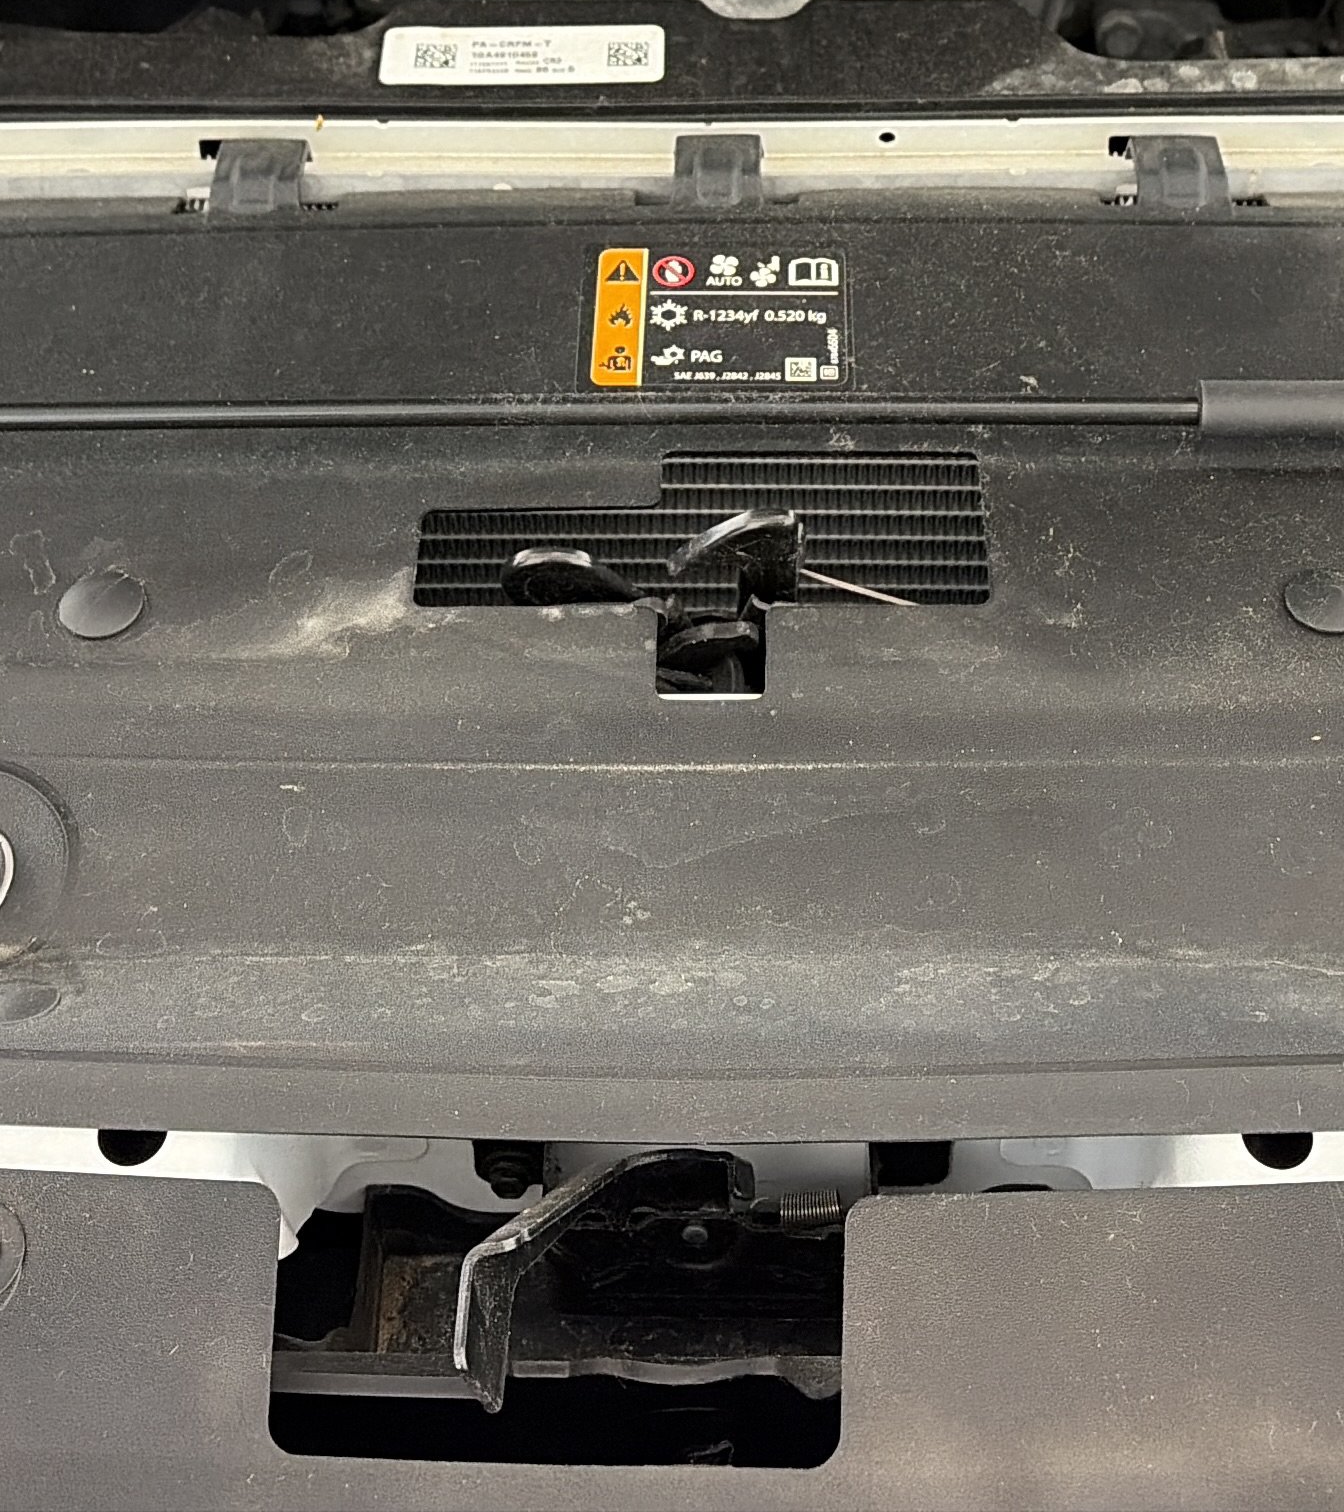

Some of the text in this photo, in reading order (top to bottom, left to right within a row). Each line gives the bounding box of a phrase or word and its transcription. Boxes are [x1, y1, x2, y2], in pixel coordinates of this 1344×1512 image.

[706, 276, 743, 287] AUTO
[693, 308, 827, 325] R-1234yf 0.520 kg
[690, 349, 723, 363] PAG
[674, 371, 692, 380] SAE
